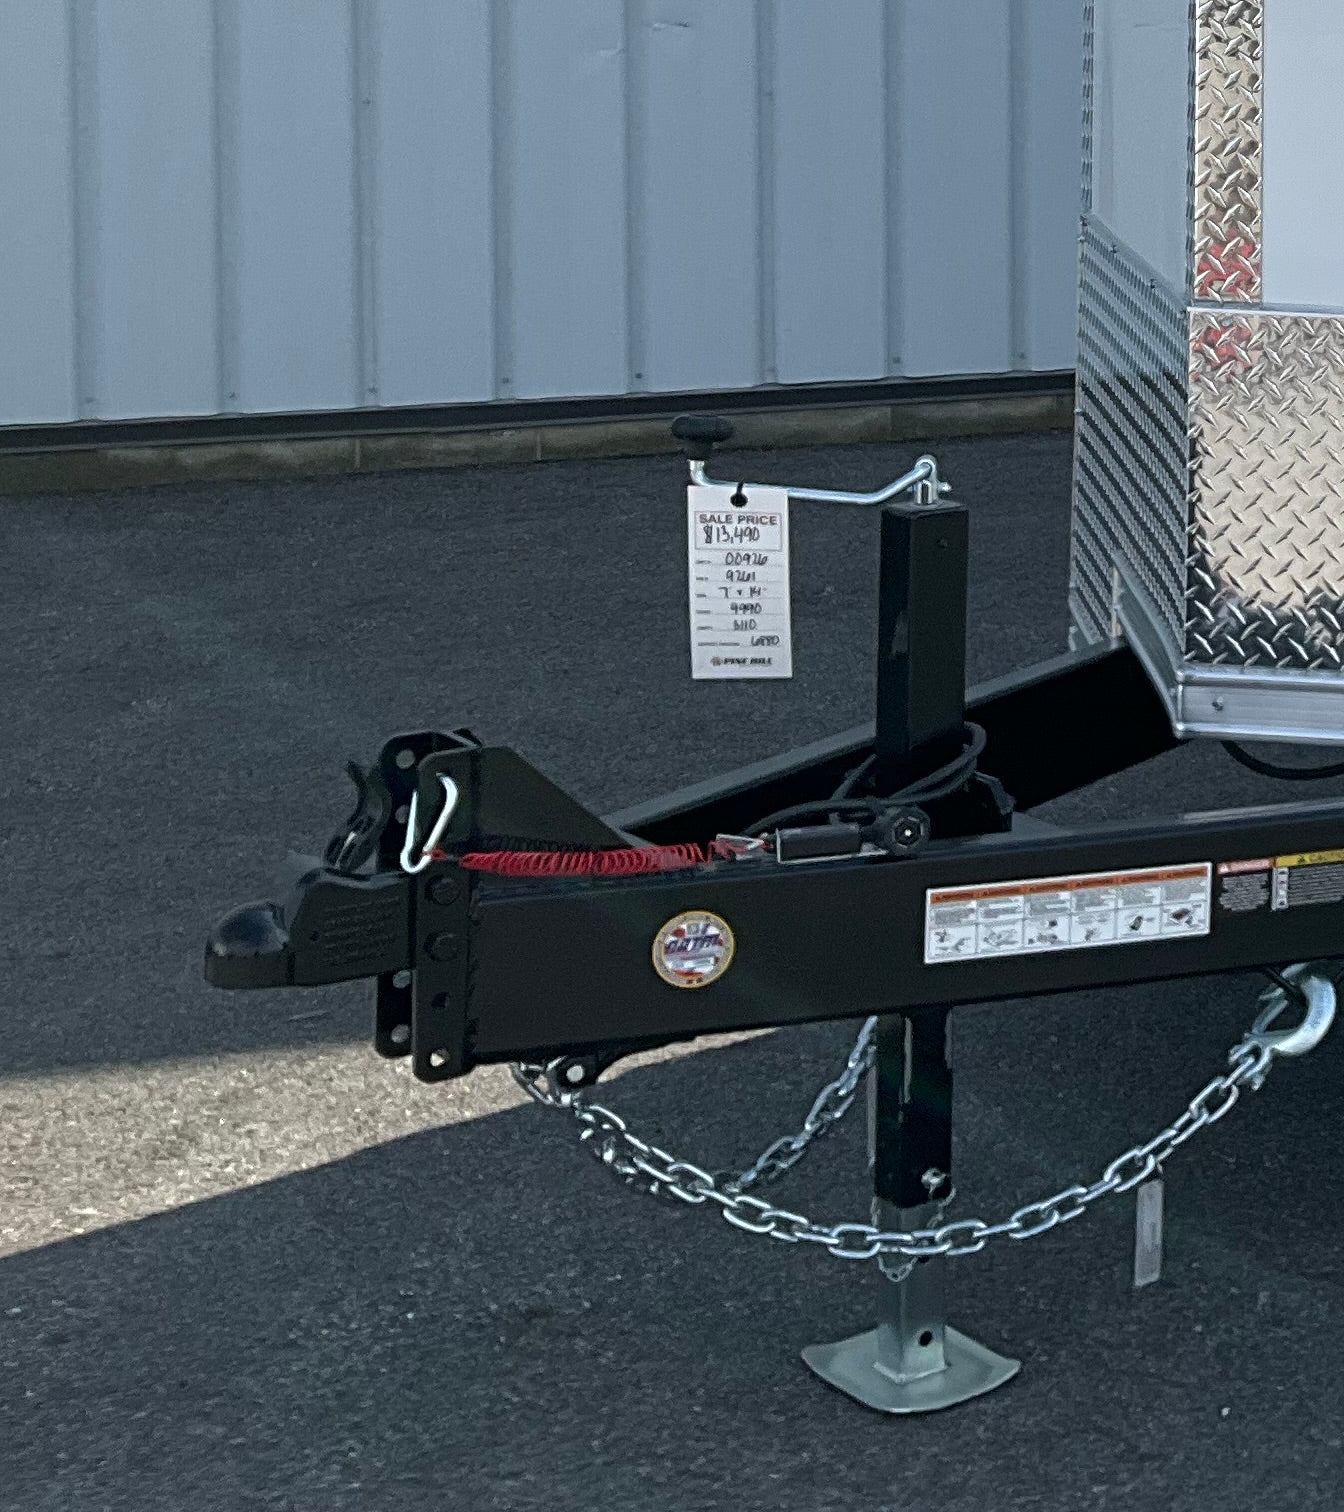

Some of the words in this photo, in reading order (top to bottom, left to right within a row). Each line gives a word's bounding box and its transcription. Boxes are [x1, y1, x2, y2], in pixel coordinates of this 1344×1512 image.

[699, 513, 733, 524] SALE
[737, 515, 778, 525] PRICE
[703, 524, 760, 544] $13,490
